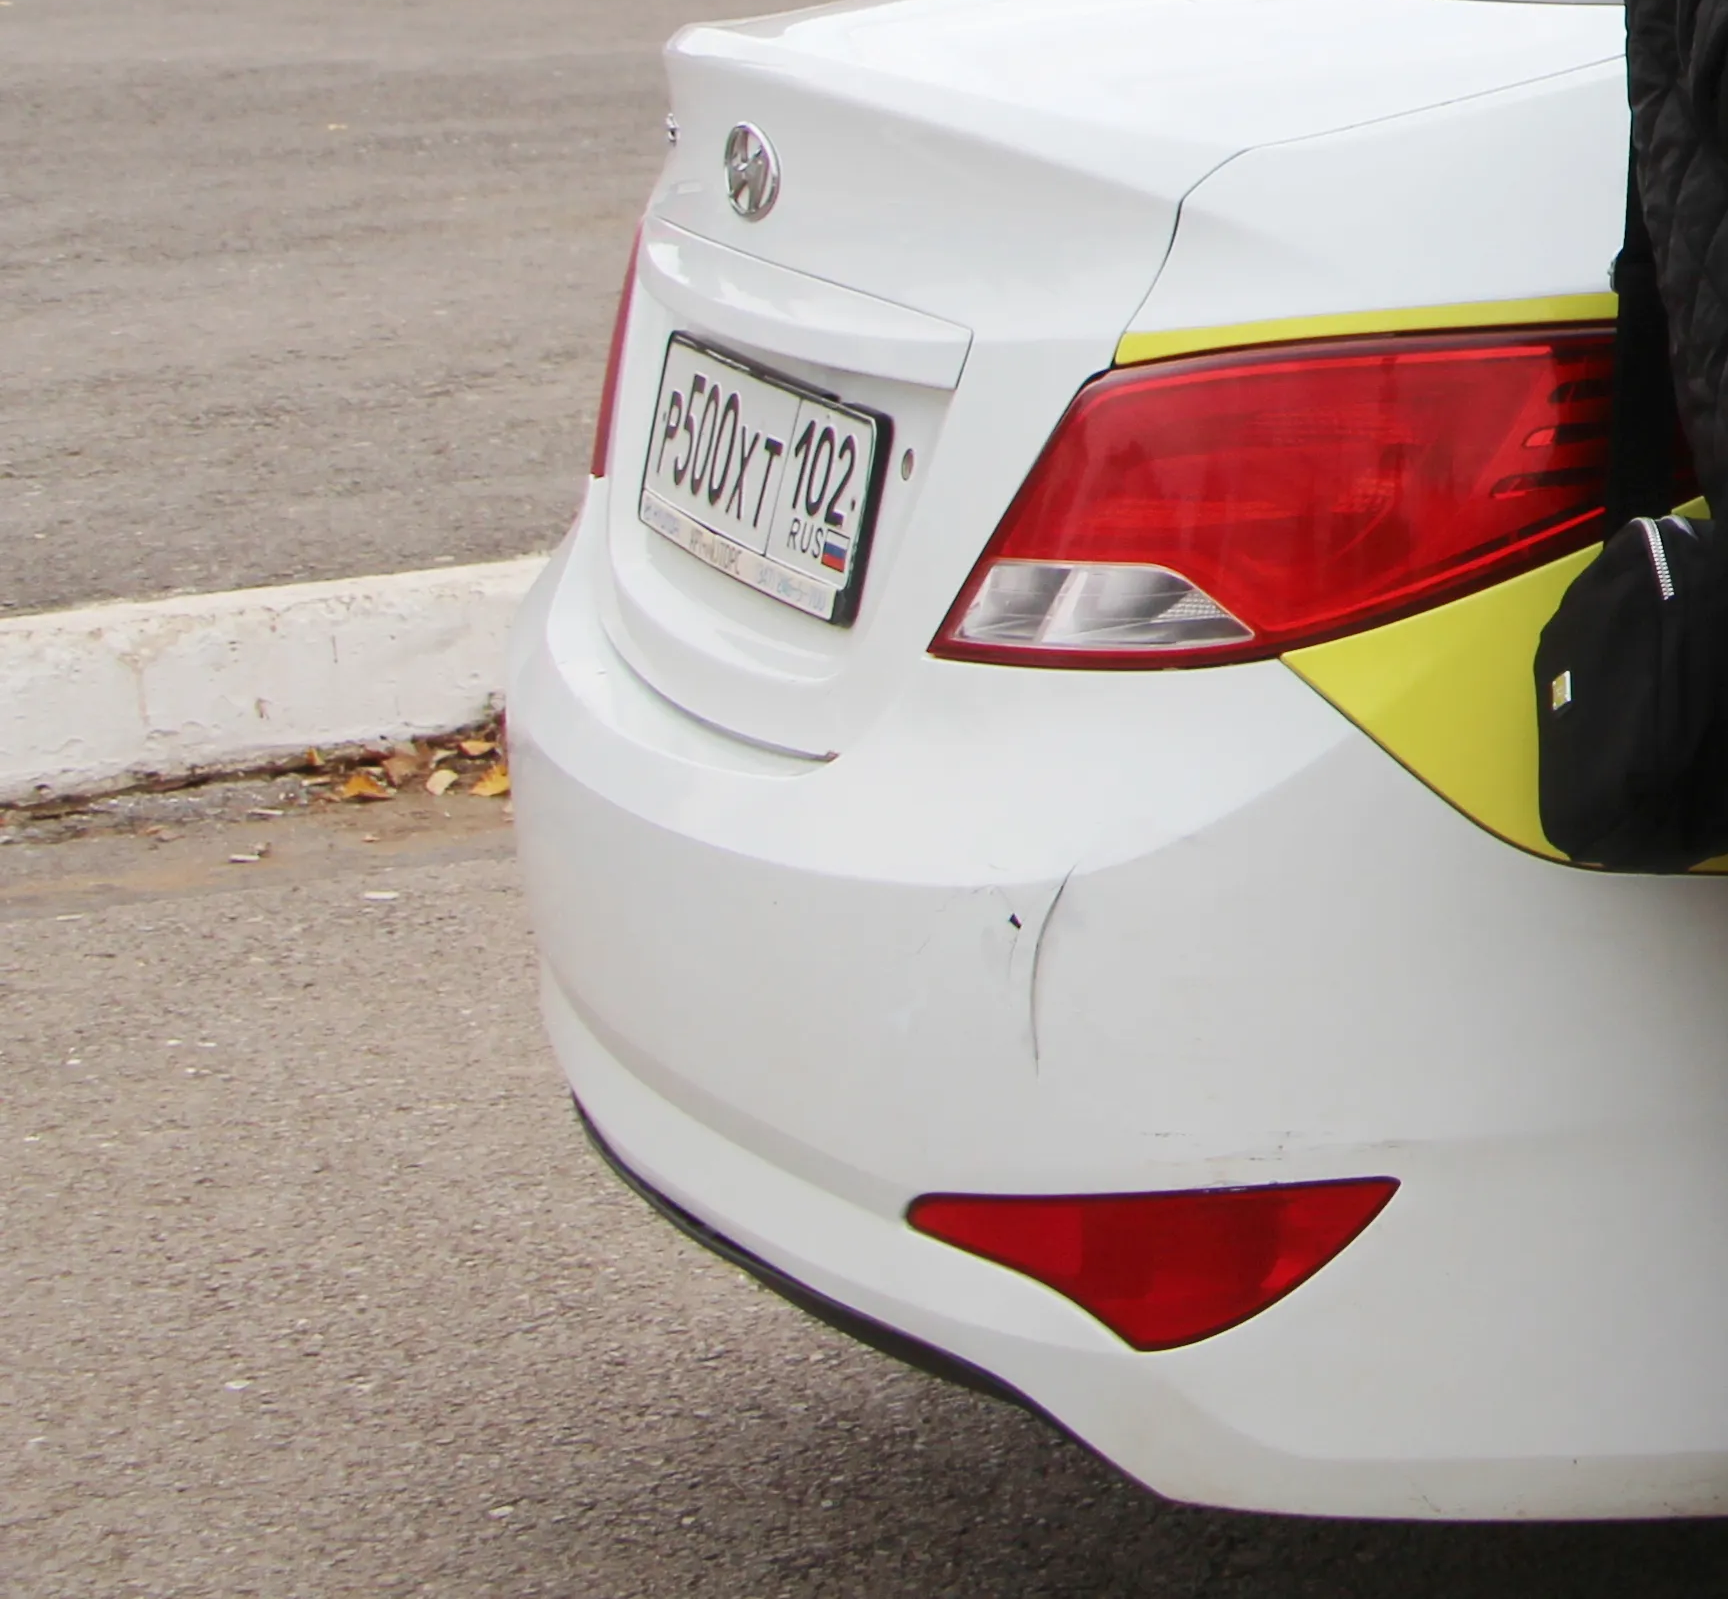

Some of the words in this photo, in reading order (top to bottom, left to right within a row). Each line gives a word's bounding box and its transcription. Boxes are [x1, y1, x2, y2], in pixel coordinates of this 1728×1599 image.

[656, 372, 784, 528] Р500ХТ
[792, 419, 857, 527] 102
[786, 517, 824, 559] RUS
